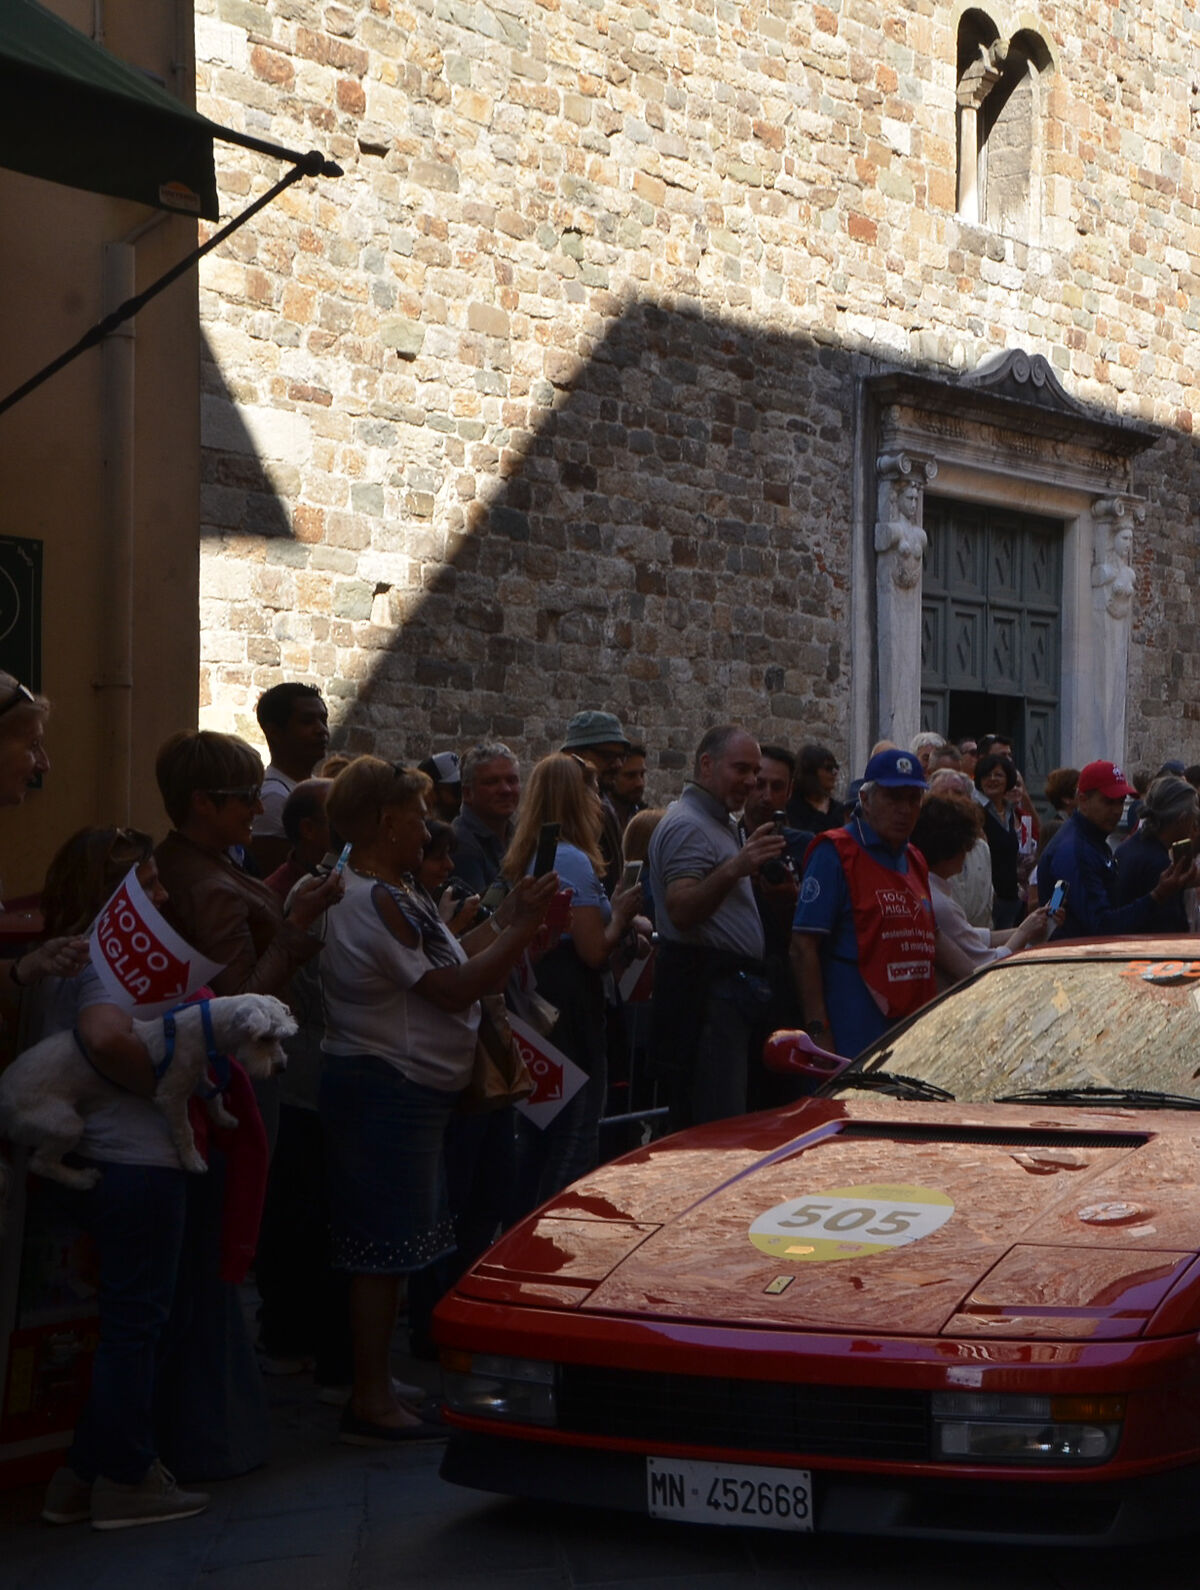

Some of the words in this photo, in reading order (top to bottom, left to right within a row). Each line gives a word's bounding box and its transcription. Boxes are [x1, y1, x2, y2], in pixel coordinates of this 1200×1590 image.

[99, 911, 151, 997] MIGLIA
[114, 899, 169, 972] 1000
[777, 1204, 921, 1236] 505
[651, 1471, 686, 1508] MN
[706, 1477, 809, 1519] 452668
